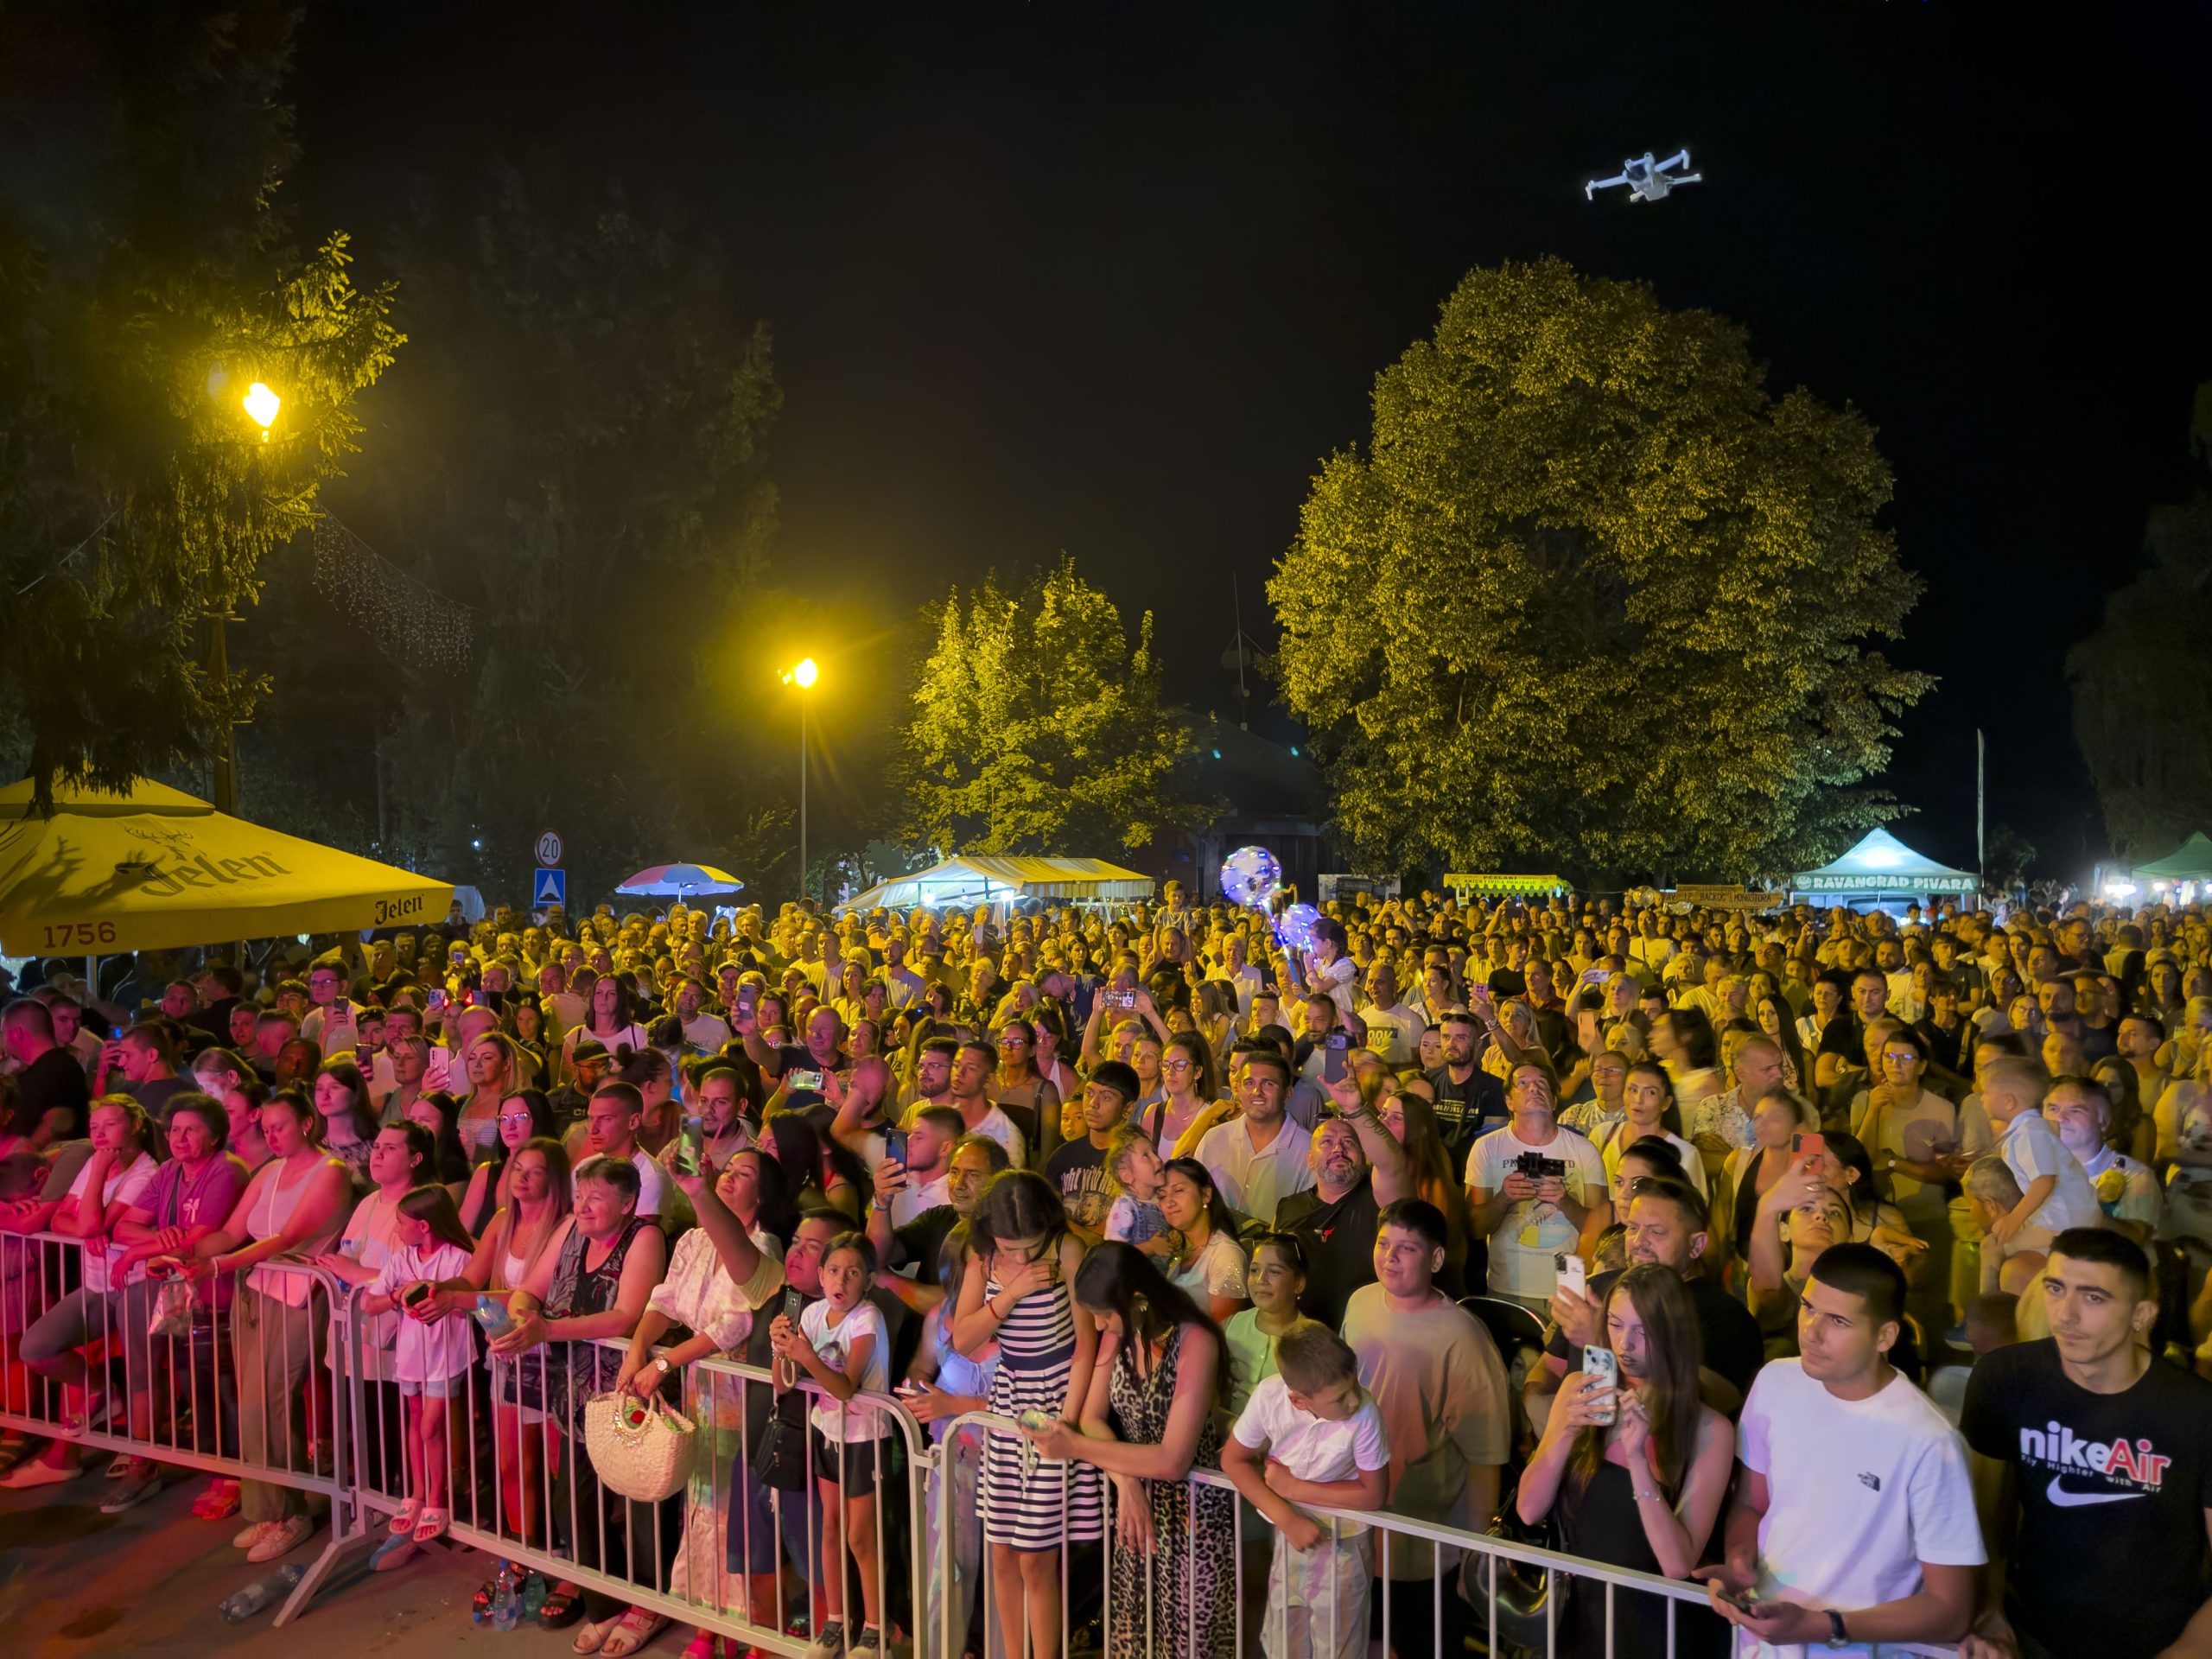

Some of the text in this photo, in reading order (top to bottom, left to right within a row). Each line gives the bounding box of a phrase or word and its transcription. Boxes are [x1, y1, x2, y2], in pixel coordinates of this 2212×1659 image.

[542, 837, 559, 859] 20
[140, 855, 293, 897] Jelen
[1813, 875, 1974, 890] RAVANGRAD PIVARA
[374, 895, 424, 925] Jelen
[43, 921, 117, 949] 1756
